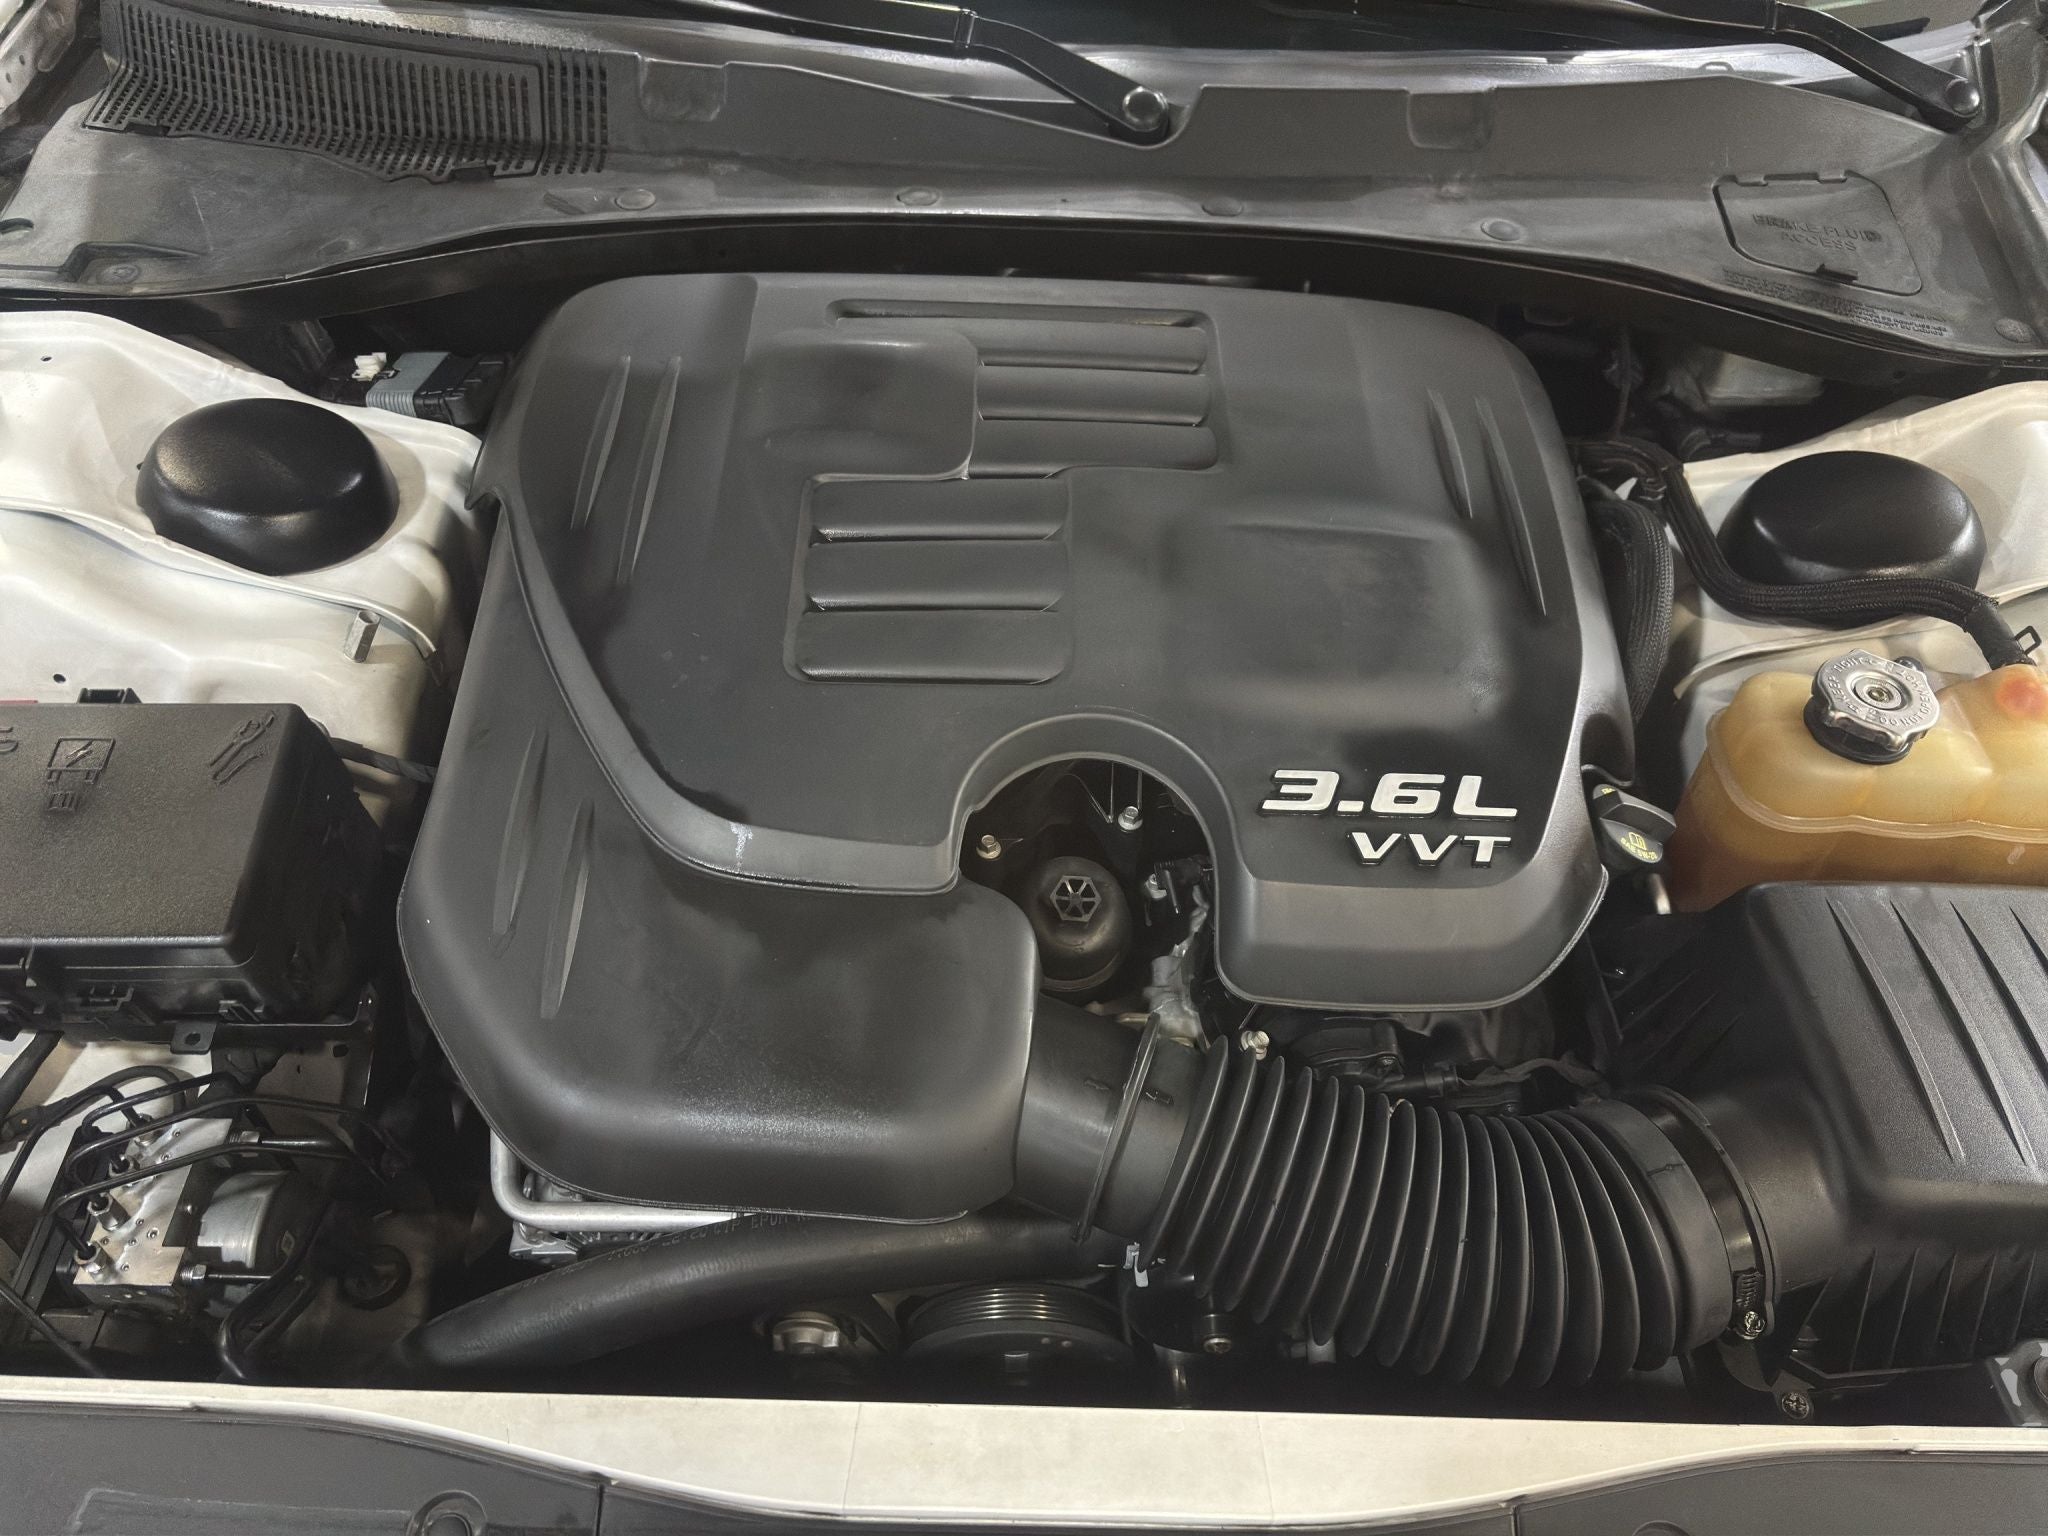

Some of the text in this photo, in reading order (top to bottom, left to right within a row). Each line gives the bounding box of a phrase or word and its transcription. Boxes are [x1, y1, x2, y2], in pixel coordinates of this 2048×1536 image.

[1781, 231, 1857, 252] ACCESS
[1823, 226, 1882, 243] FLUID
[1900, 712, 1924, 727] NOT
[1261, 769, 1518, 819] 3.6L
[1348, 831, 1511, 866] VVT
